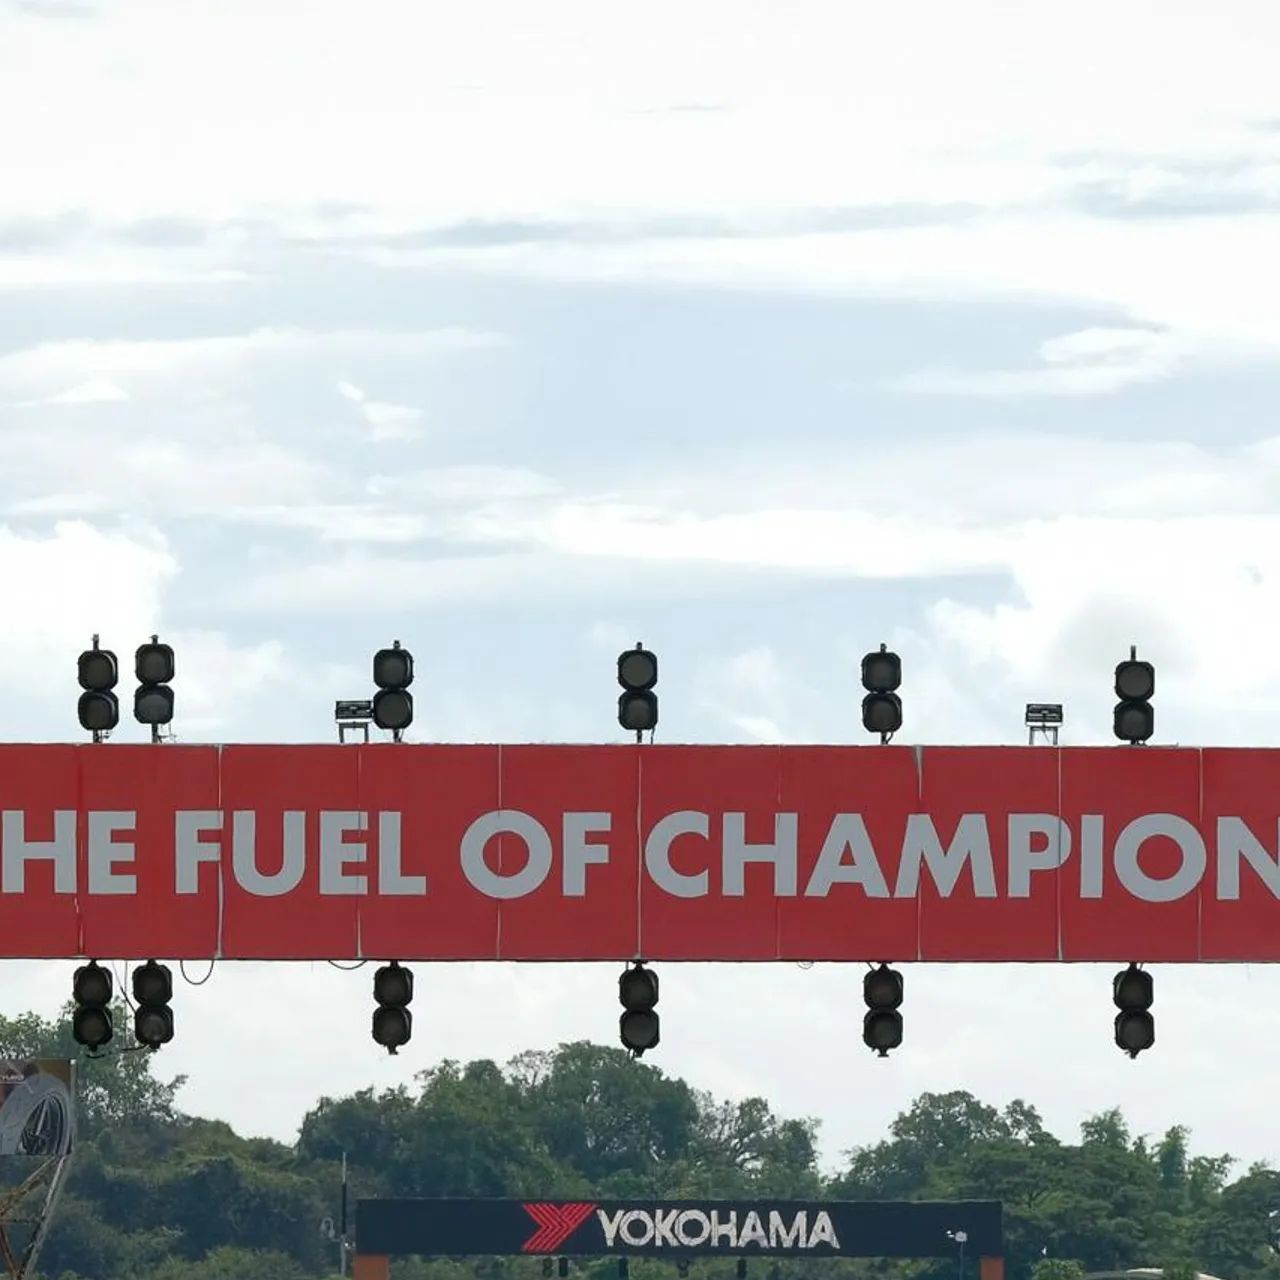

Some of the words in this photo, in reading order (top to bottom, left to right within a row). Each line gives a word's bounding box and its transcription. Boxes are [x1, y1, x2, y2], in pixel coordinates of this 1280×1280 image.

[175, 810, 427, 897] FUEL
[460, 809, 612, 899] OF
[596, 1208, 841, 1249] YOKOHAMA
